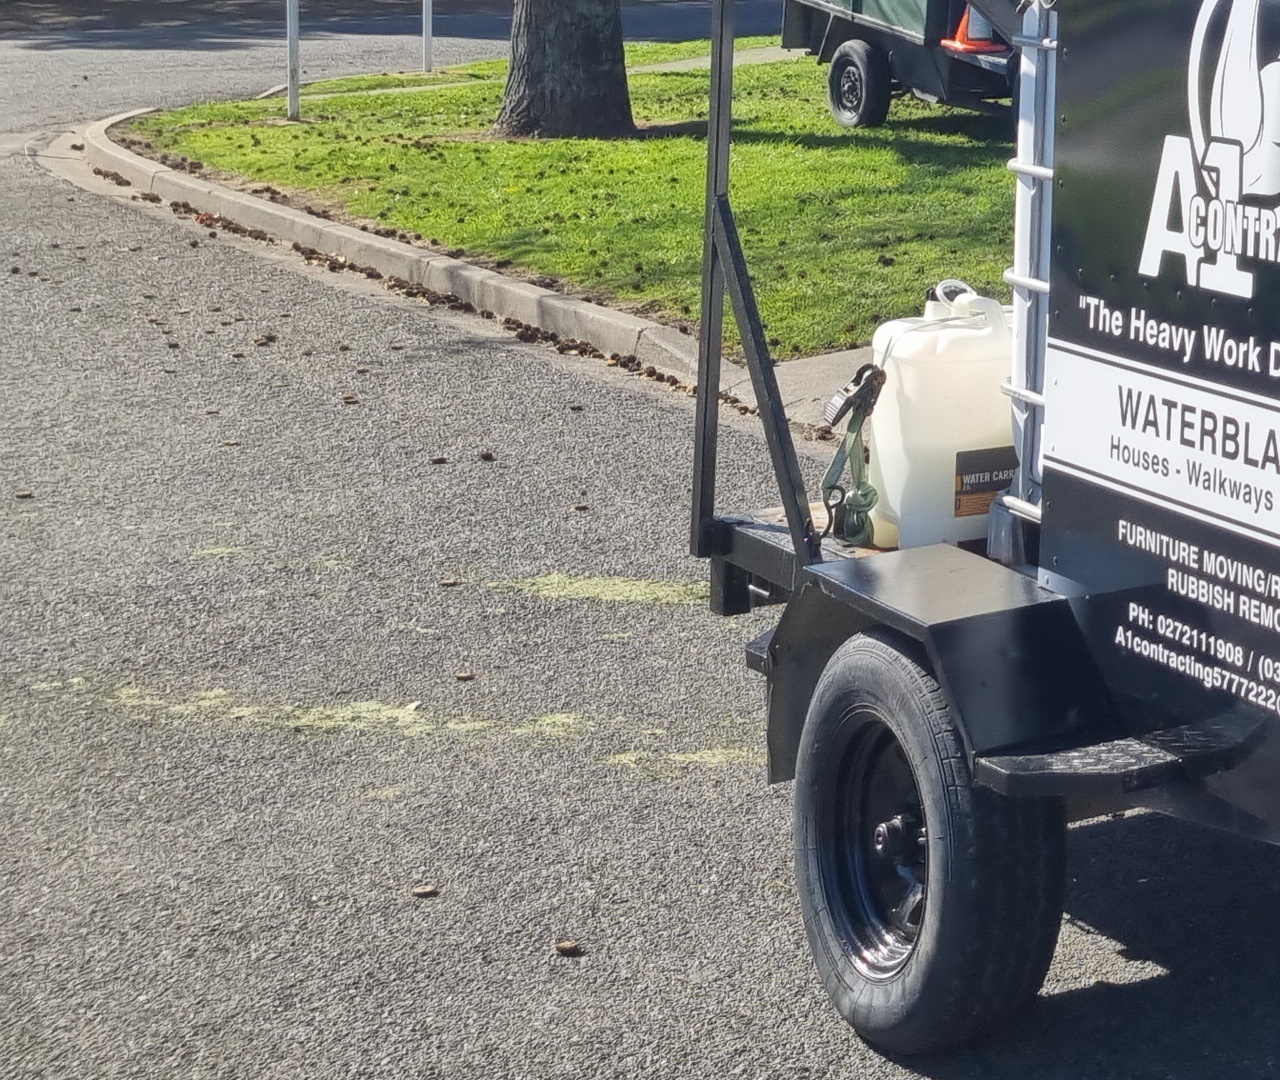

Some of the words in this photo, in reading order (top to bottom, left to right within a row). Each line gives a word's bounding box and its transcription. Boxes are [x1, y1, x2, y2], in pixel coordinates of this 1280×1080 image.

[1138, 134, 1253, 299] A1
[1080, 296, 1123, 336] "The
[1130, 307, 1196, 363] Heavy
[1203, 325, 1260, 373] Work
[963, 472, 990, 485] WATER
[992, 469, 1015, 482] CARR
[1110, 435, 1169, 478] Houses
[1187, 461, 1274, 513] Walkways
[1119, 520, 1199, 570] FURNITURE
[1168, 568, 1235, 614] RUBBISH
[1129, 603, 1153, 632] PH:
[1157, 617, 1244, 668] 0272111908
